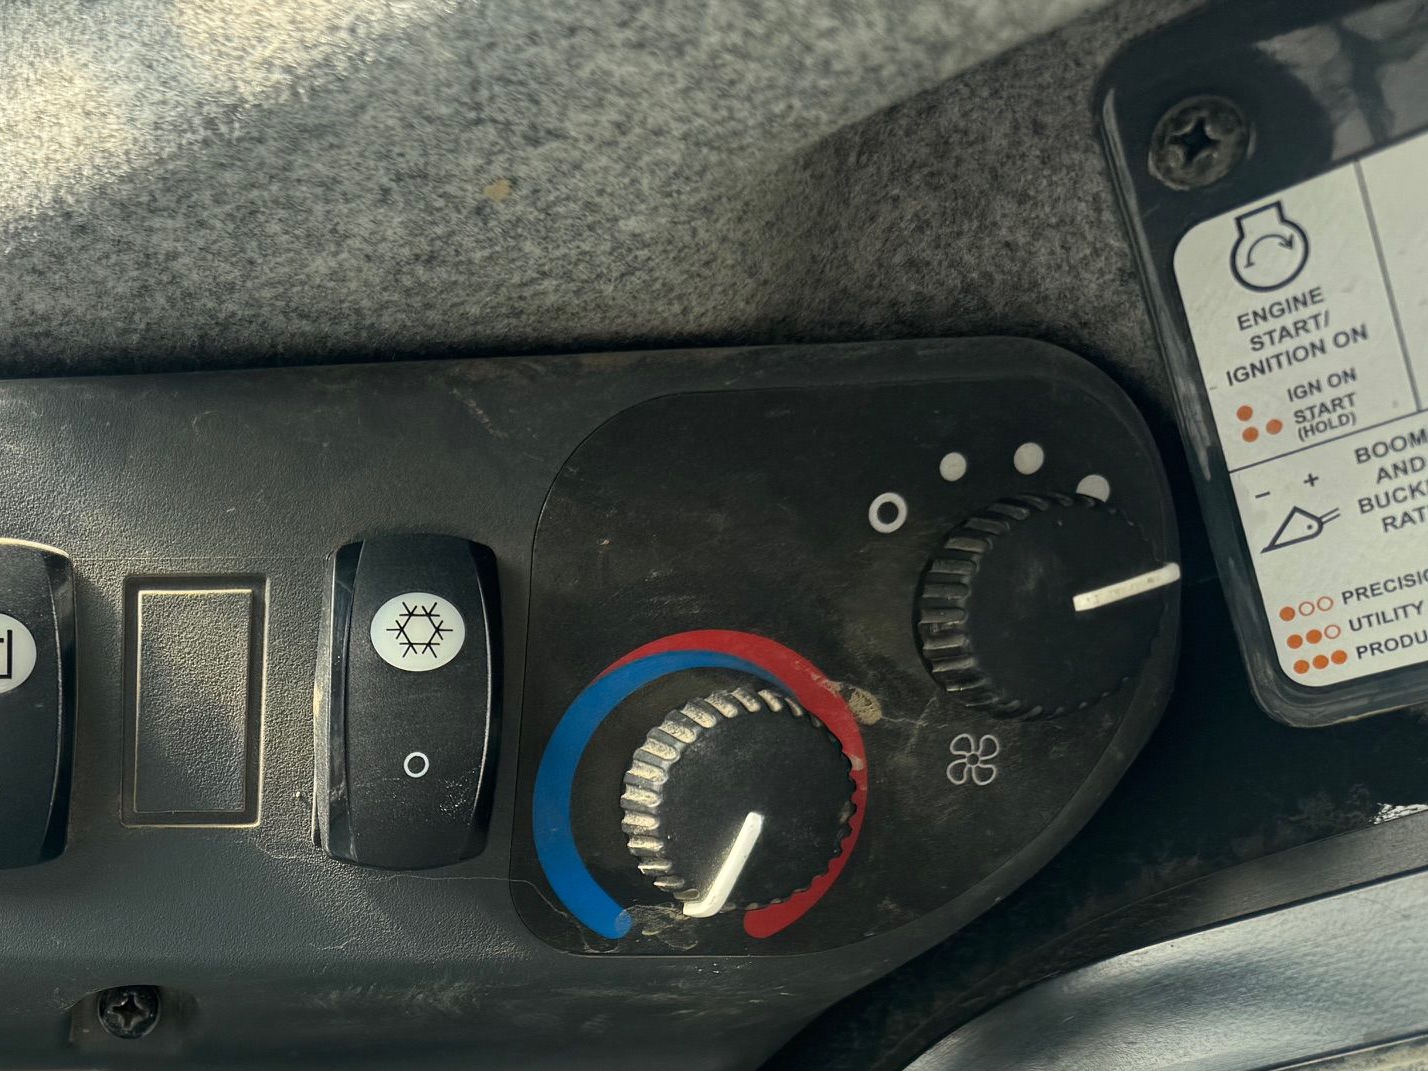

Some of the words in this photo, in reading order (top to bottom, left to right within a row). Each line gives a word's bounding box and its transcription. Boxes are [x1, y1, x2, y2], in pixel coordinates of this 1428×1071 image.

[1237, 287, 1325, 331] ENGINE
[1250, 310, 1330, 351] START/
[1226, 339, 1327, 386] IGNITION
[1332, 324, 1369, 349] ON
[1287, 380, 1322, 402] IGN
[1327, 368, 1357, 388] ON
[1293, 393, 1356, 424] START
[1298, 411, 1357, 442] (HOLD)
[1354, 428, 1427, 464] BOOM
[1376, 456, 1425, 485] AND
[1358, 480, 1428, 514] BUCK
[1382, 506, 1428, 533] RAT
[1348, 600, 1424, 632] UTILITY
